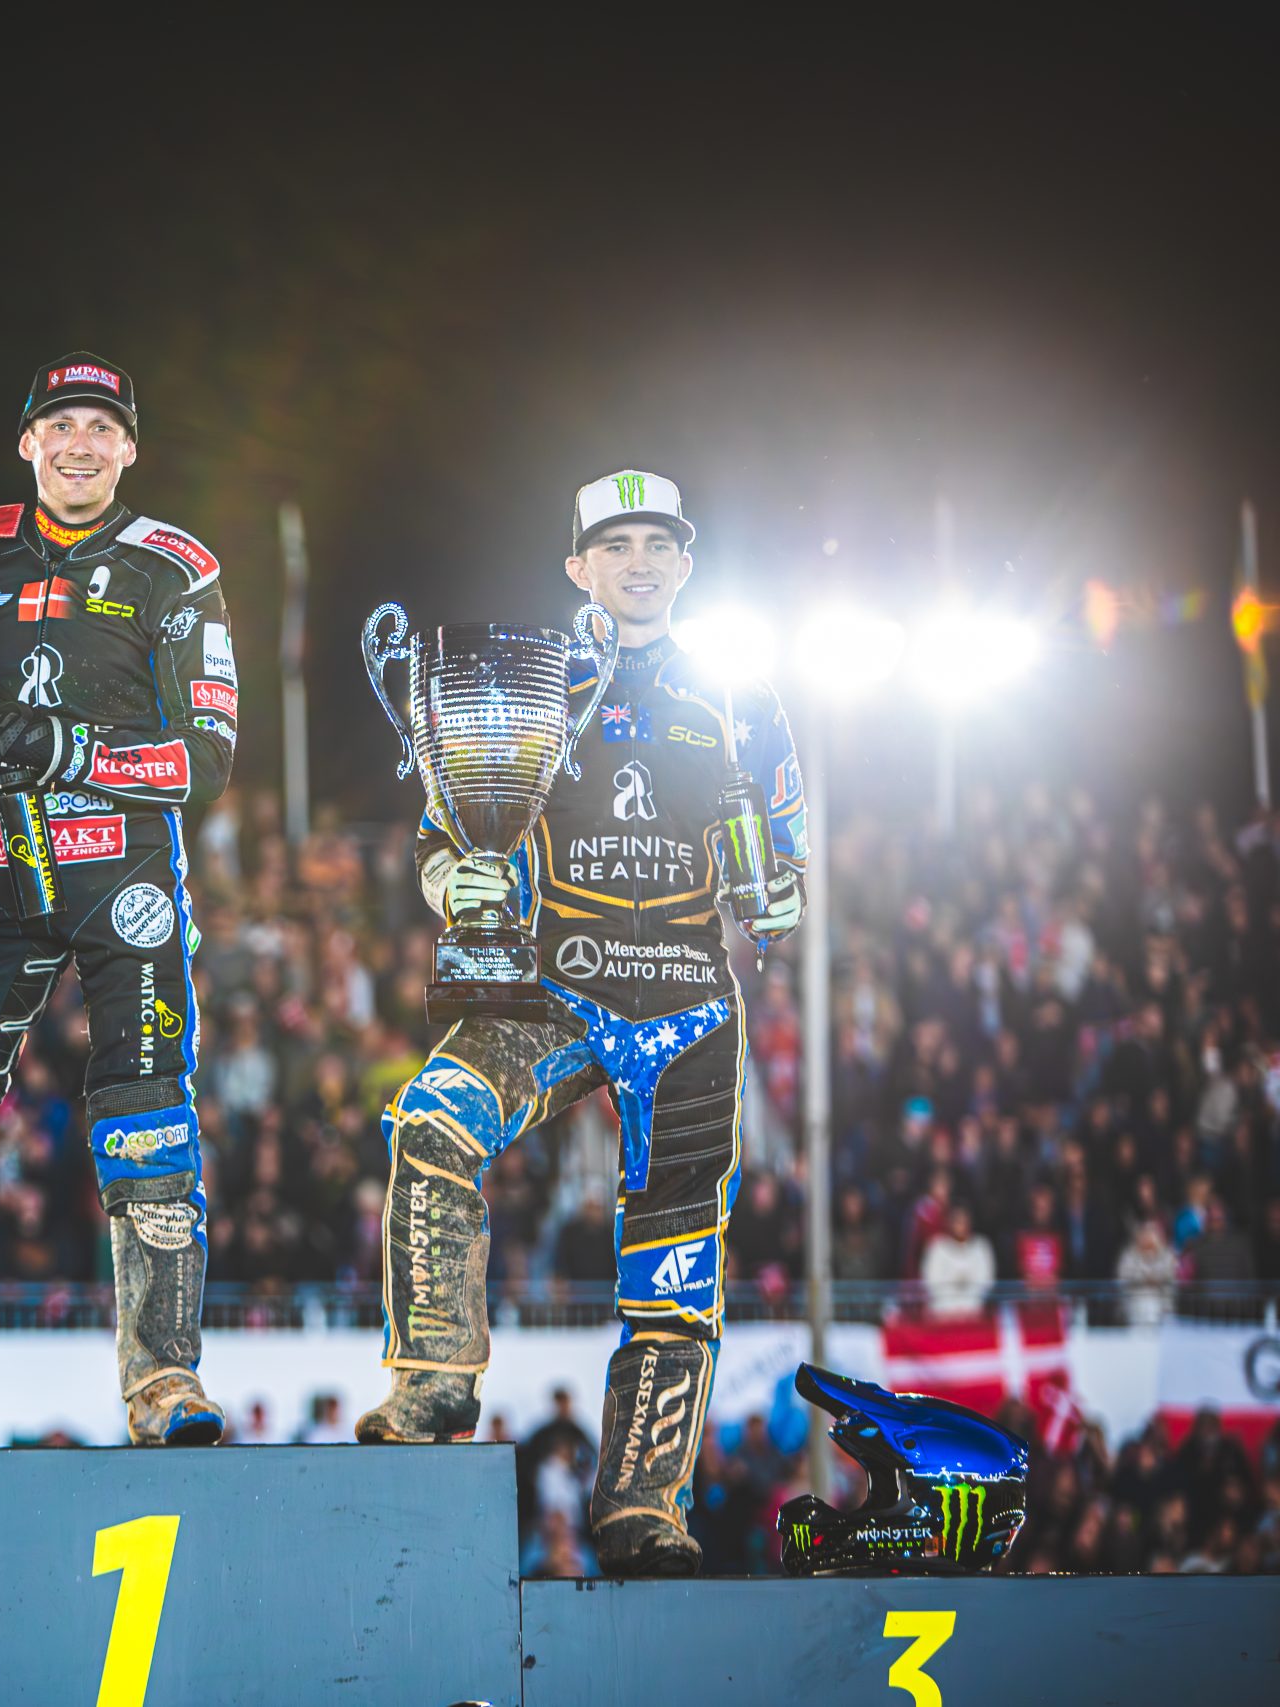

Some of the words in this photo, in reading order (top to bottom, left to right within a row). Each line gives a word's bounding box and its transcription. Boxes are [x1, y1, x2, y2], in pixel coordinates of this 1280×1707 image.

[65, 366, 117, 384] IMPAKT
[149, 533, 207, 568] KLOSTER
[97, 758, 178, 779] KLOSTER
[72, 846, 115, 855] ZNICZY
[569, 835, 694, 865] INFINITE
[569, 861, 694, 886] REALITY
[127, 897, 157, 927] Fabryka
[127, 900, 171, 942] Rowerow.com
[469, 947, 505, 957] THIRD
[604, 960, 656, 979] AUTO
[661, 963, 718, 984] FRELIK
[409, 1179, 431, 1305] MONSTER
[431, 1190, 445, 1297] ENERGY
[856, 1526, 933, 1541] MONSTER
[93, 1516, 180, 1707] 1
[882, 1610, 958, 1707] 3
